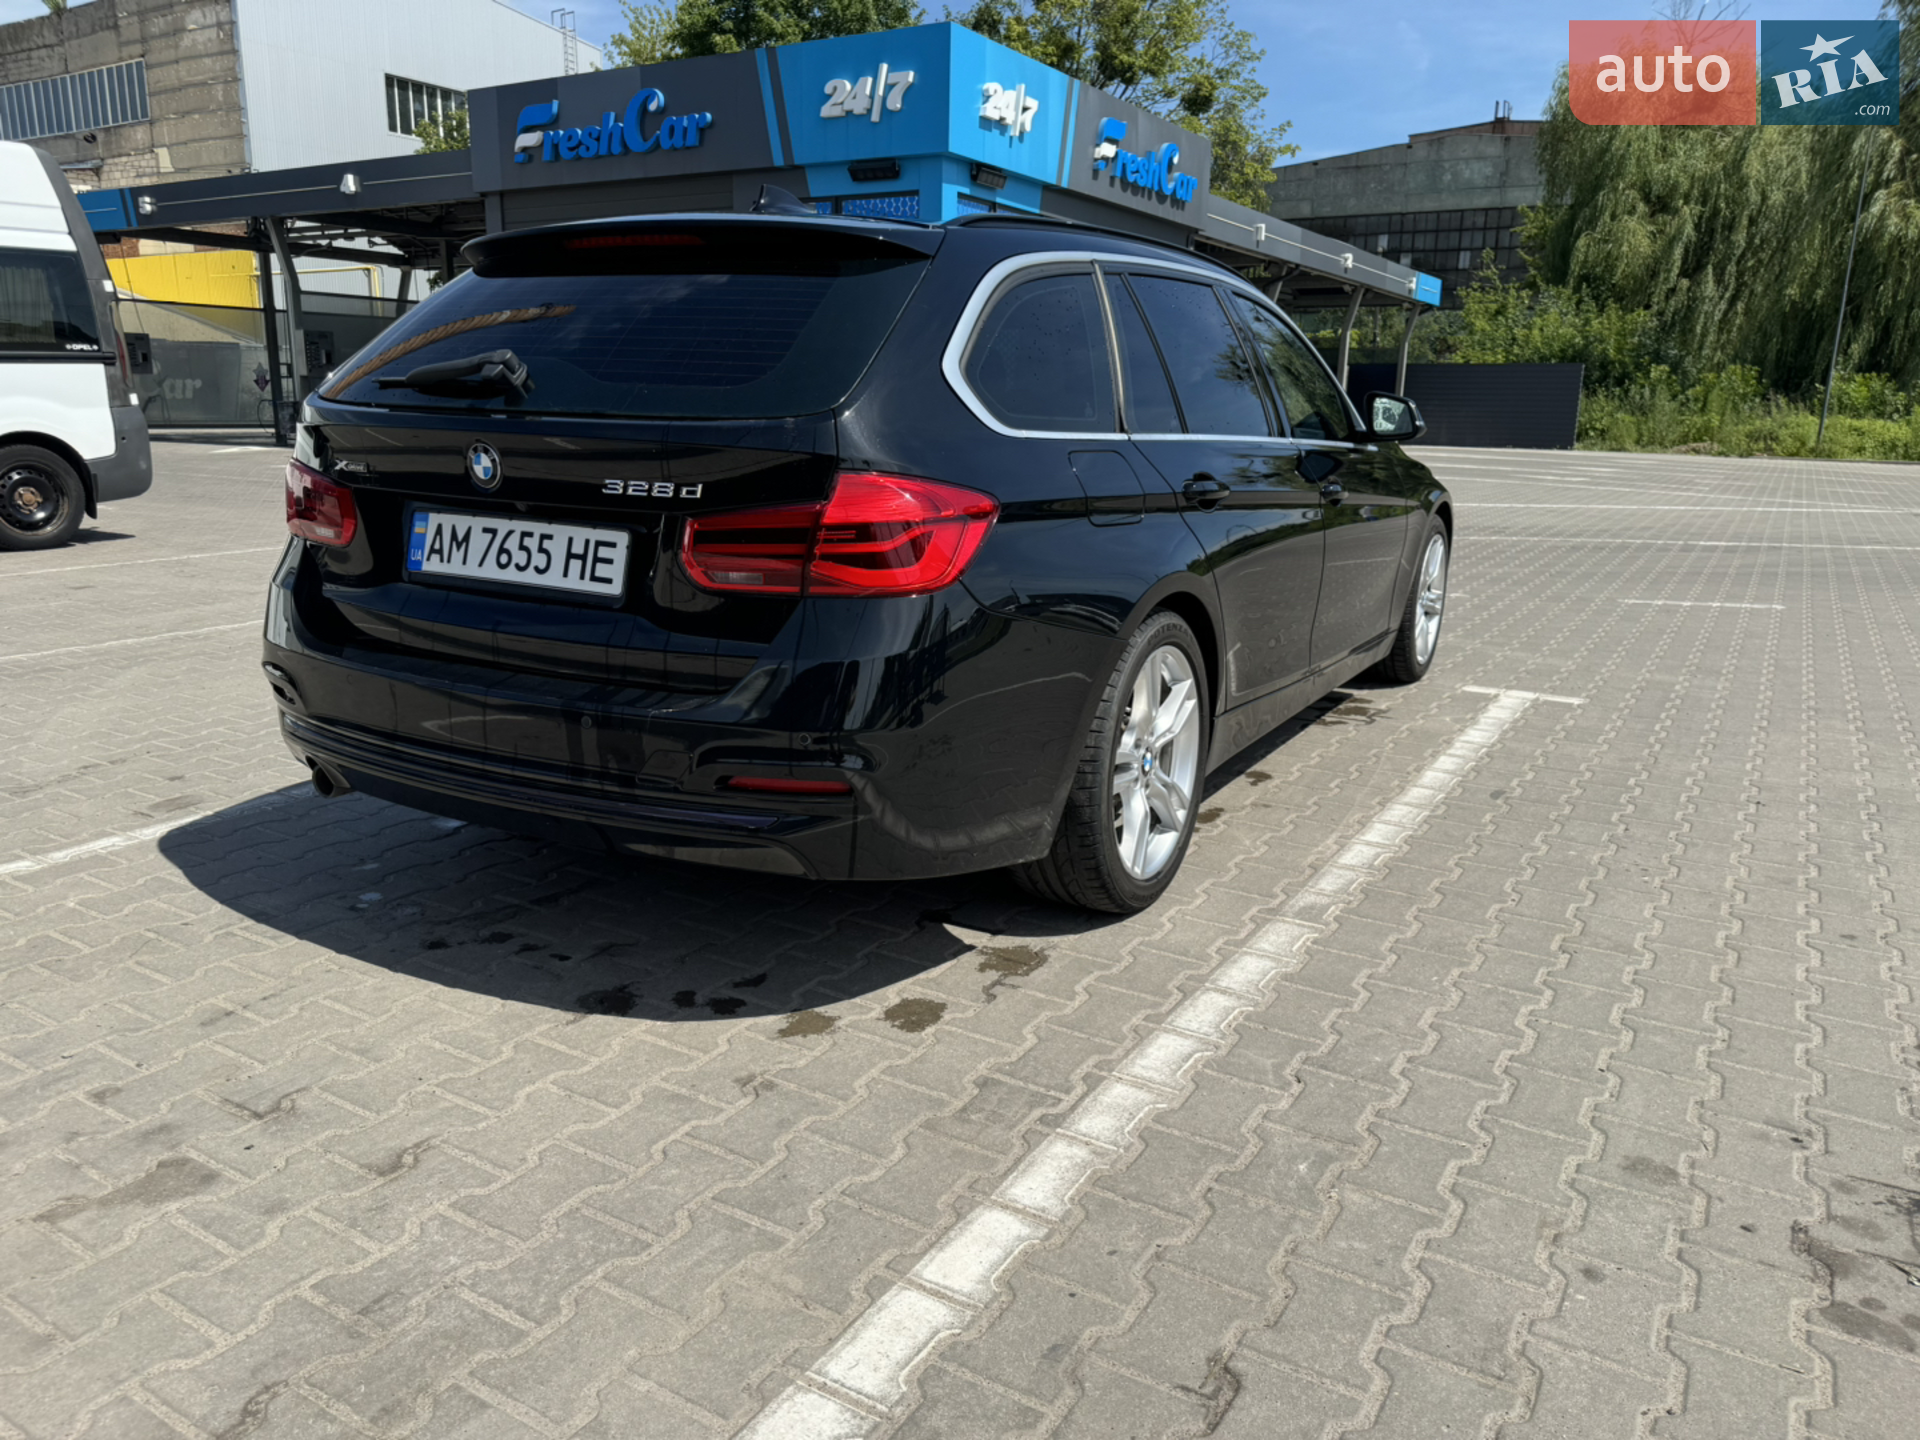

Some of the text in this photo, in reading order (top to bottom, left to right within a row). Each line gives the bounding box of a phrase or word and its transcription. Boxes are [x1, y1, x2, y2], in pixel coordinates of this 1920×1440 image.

[819, 62, 914, 123] 24/7
[979, 82, 1038, 137] 24/7
[514, 87, 713, 164] FreshCar
[1093, 117, 1198, 203] FreshCar
[410, 548, 422, 561] UA
[426, 522, 618, 585] AM 7655 HE
